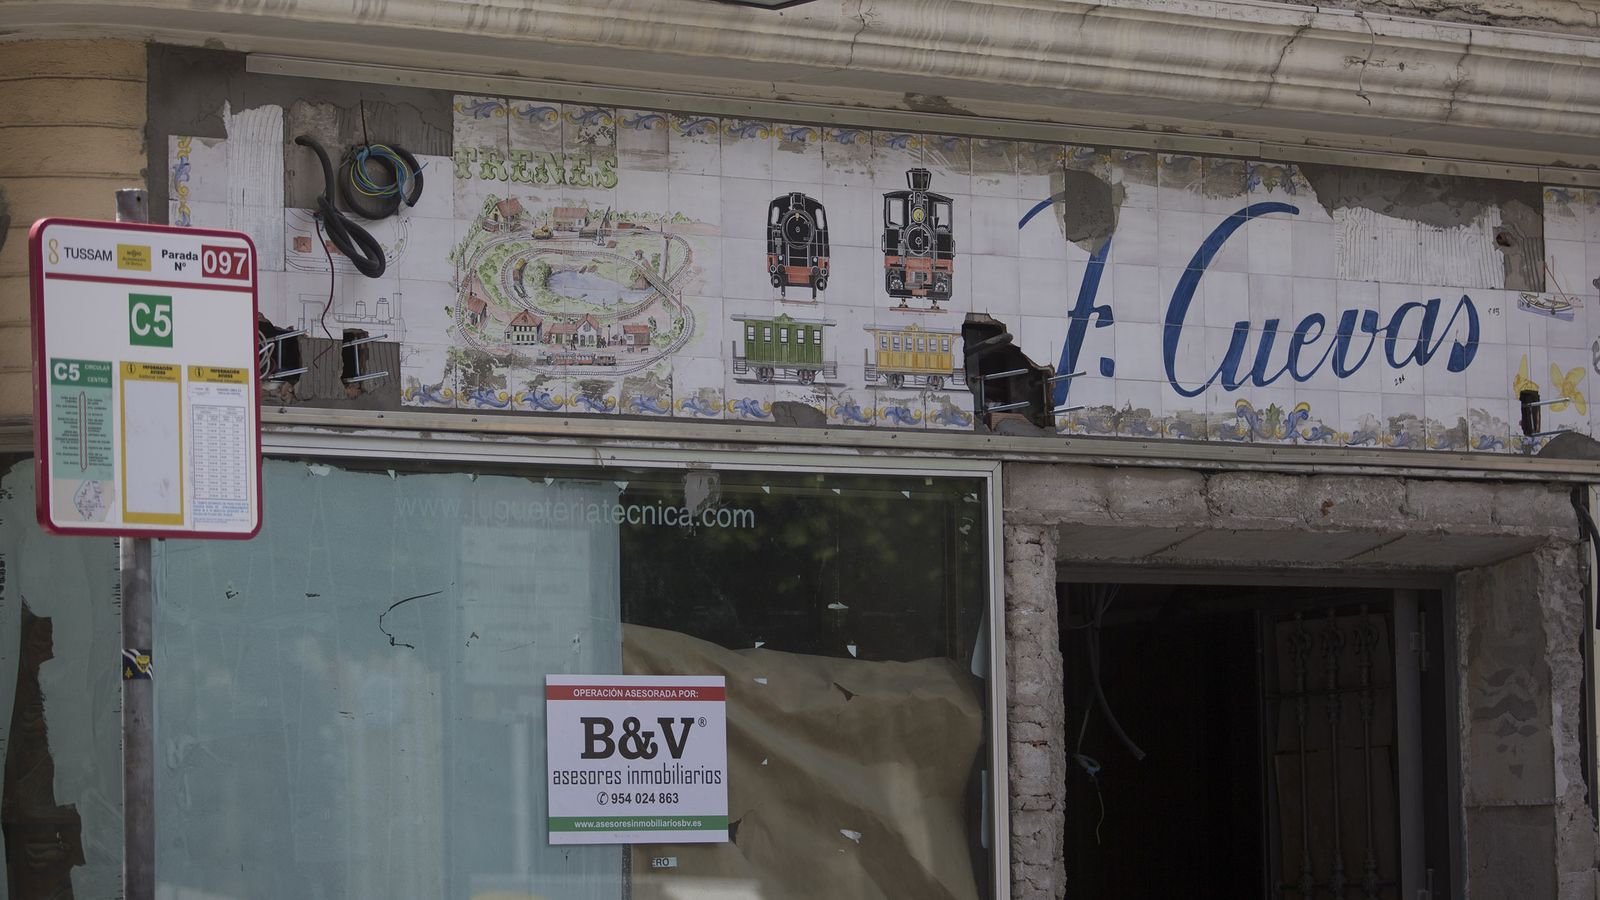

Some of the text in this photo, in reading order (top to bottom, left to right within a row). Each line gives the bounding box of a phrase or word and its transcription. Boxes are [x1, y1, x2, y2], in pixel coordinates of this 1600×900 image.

[453, 148, 618, 188] TRENES
[63, 246, 113, 262] TUSSAM
[161, 249, 199, 261] Parada
[203, 250, 247, 275] 097
[1163, 201, 1480, 398] Cuevas
[131, 302, 172, 338] C5
[53, 362, 81, 381] C5
[87, 376, 109, 384] CENTRO
[573, 687, 699, 698] OPERACIÓN ASESORADA POR:
[553, 762, 722, 785] asesores inmobiliarios
[611, 792, 679, 805] 954 024 863
[574, 819, 702, 829] www.asesoresinmobiliariosbv.es
